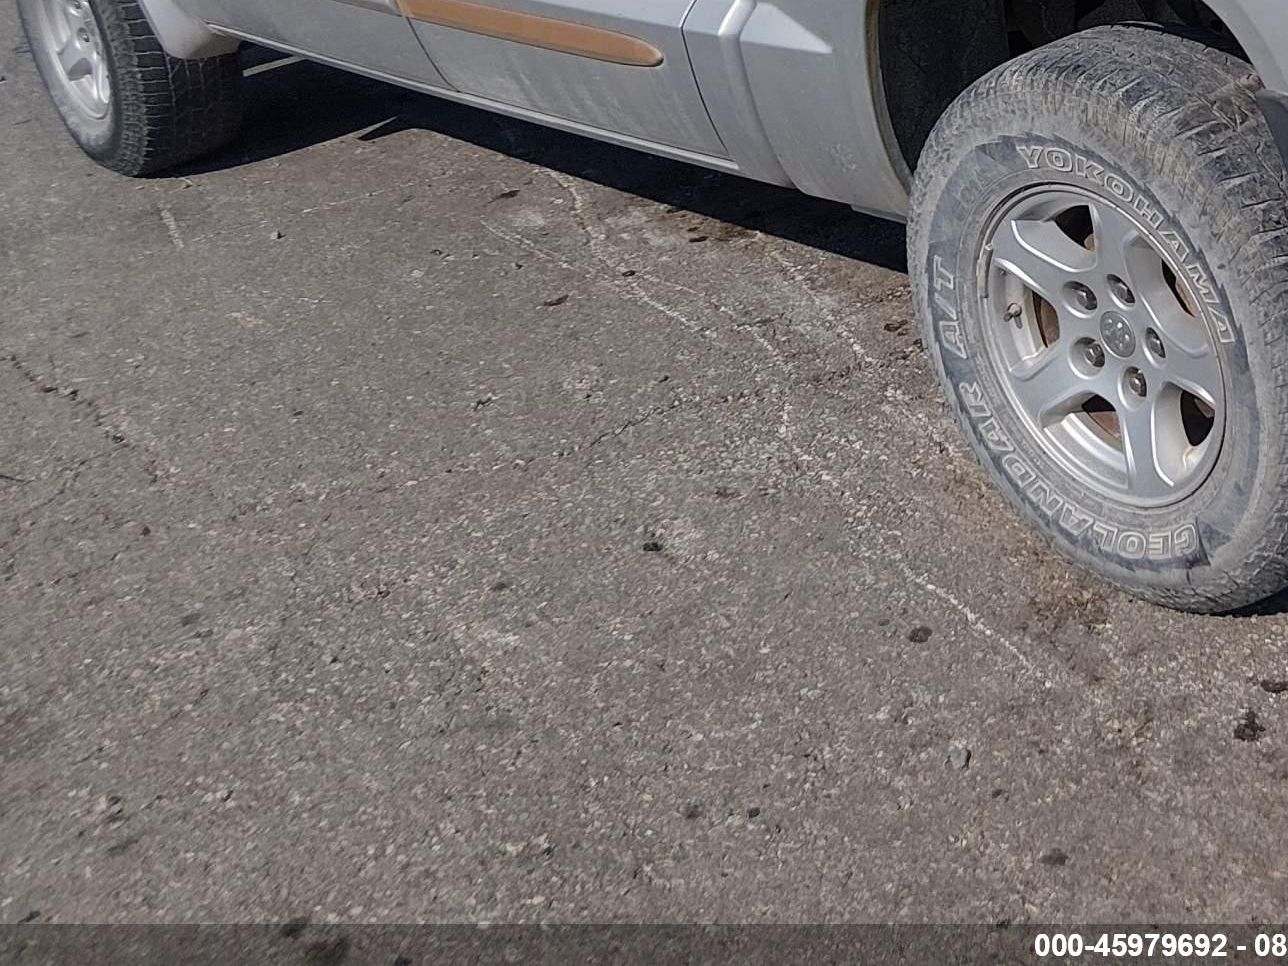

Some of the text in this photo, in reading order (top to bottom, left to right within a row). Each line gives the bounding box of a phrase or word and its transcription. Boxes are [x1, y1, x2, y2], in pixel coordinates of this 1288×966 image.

[1015, 145, 1235, 344] YOKOHAMA
[932, 254, 1199, 560] GEOLANDAR A/T
